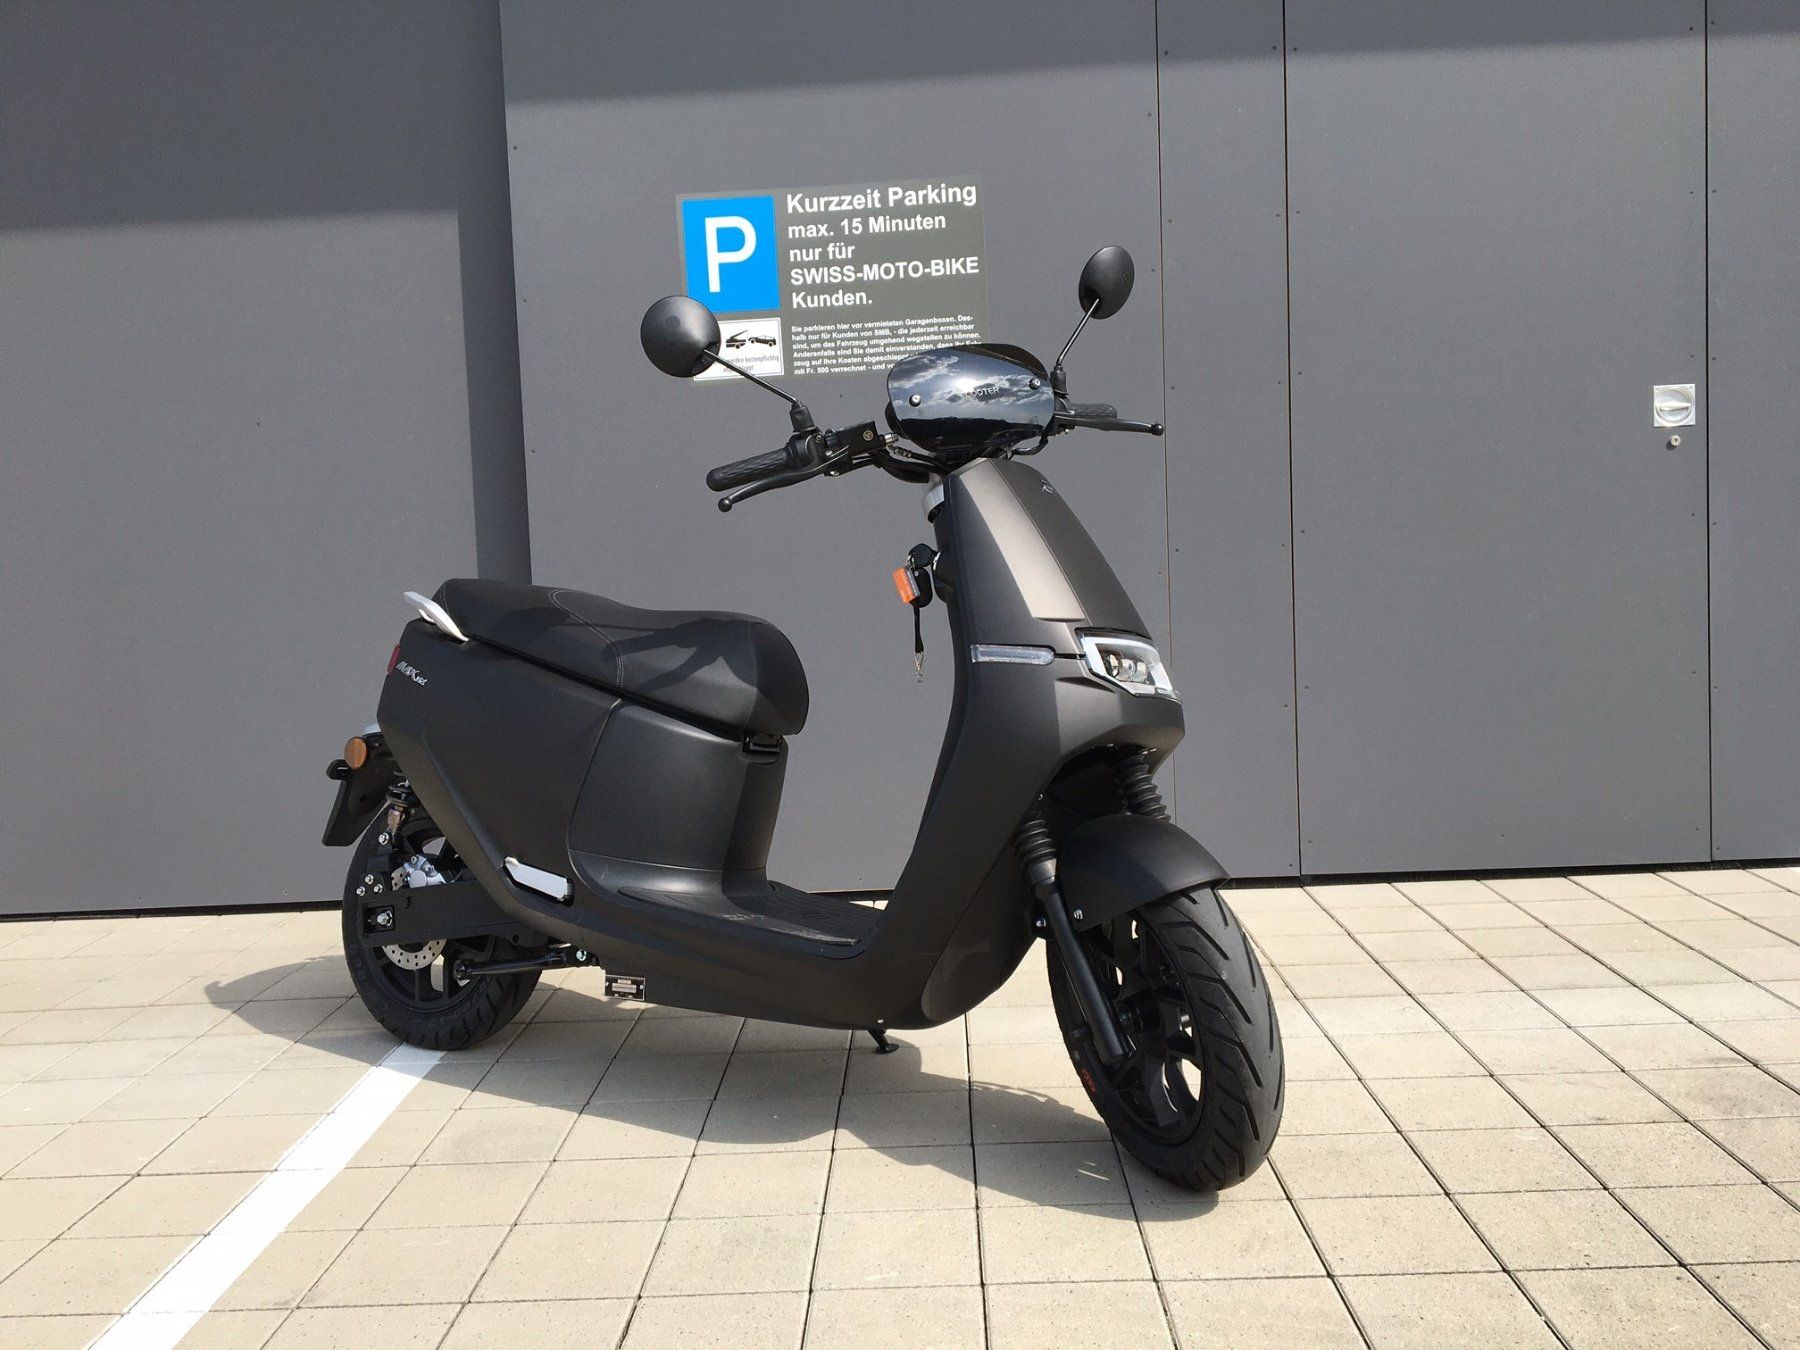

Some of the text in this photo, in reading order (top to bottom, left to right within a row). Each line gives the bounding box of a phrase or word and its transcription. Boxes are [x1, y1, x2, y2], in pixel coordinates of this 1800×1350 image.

[787, 183, 977, 214] Kurzzeit Parking
[788, 213, 946, 239] max. 15 Minuten
[704, 215, 757, 293] P
[789, 241, 856, 262] nur für
[790, 256, 980, 286] SWISS-MOTO-BIKE
[792, 289, 873, 309] Kunden.
[791, 325, 802, 333] Sie
[803, 324, 836, 333] parkieren
[836, 322, 850, 330] hier
[791, 333, 806, 341] halb
[820, 331, 831, 340] für
[832, 331, 859, 339] Kunden
[897, 327, 909, 335] die
[939, 323, 975, 331] erreichbar
[822, 340, 836, 348] das
[836, 339, 868, 347] Fahrzeug
[869, 336, 906, 346] umgehend
[836, 348, 852, 356] sind
[852, 347, 864, 355] Sie
[865, 346, 885, 354] damit
[794, 367, 806, 375] mit
[830, 364, 867, 373] verrechnet
[811, 358, 823, 366] auf
[837, 356, 862, 364] Kosten
